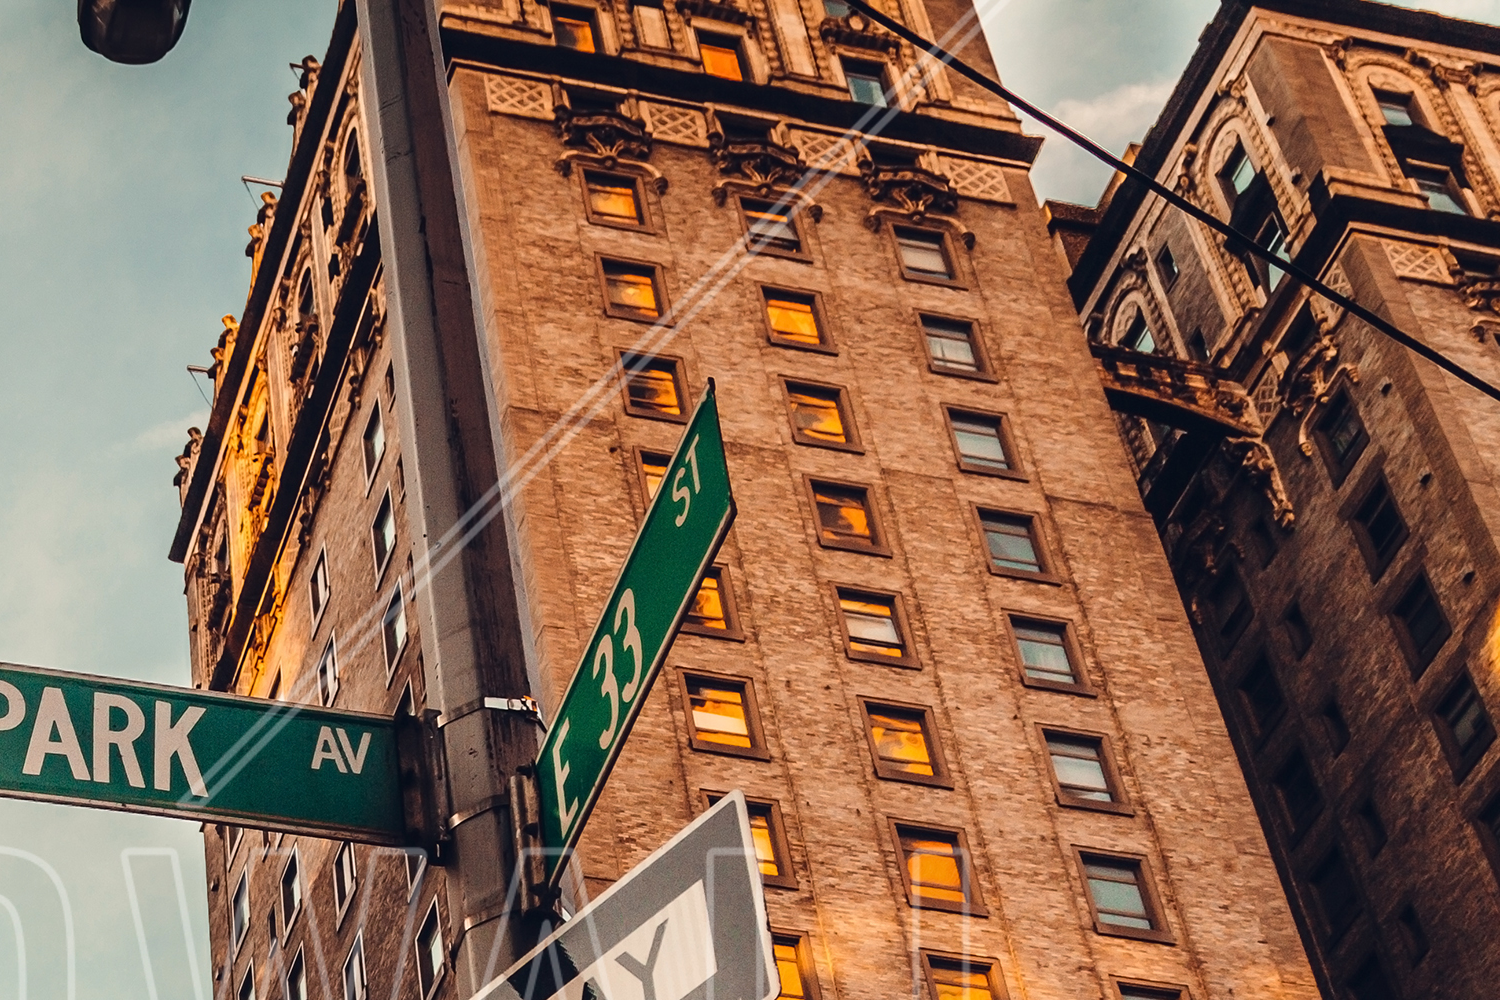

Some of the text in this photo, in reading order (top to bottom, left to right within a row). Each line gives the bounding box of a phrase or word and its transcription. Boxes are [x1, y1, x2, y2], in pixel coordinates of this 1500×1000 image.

[311, 725, 372, 775] AV
[550, 435, 701, 839] E 33 ST
